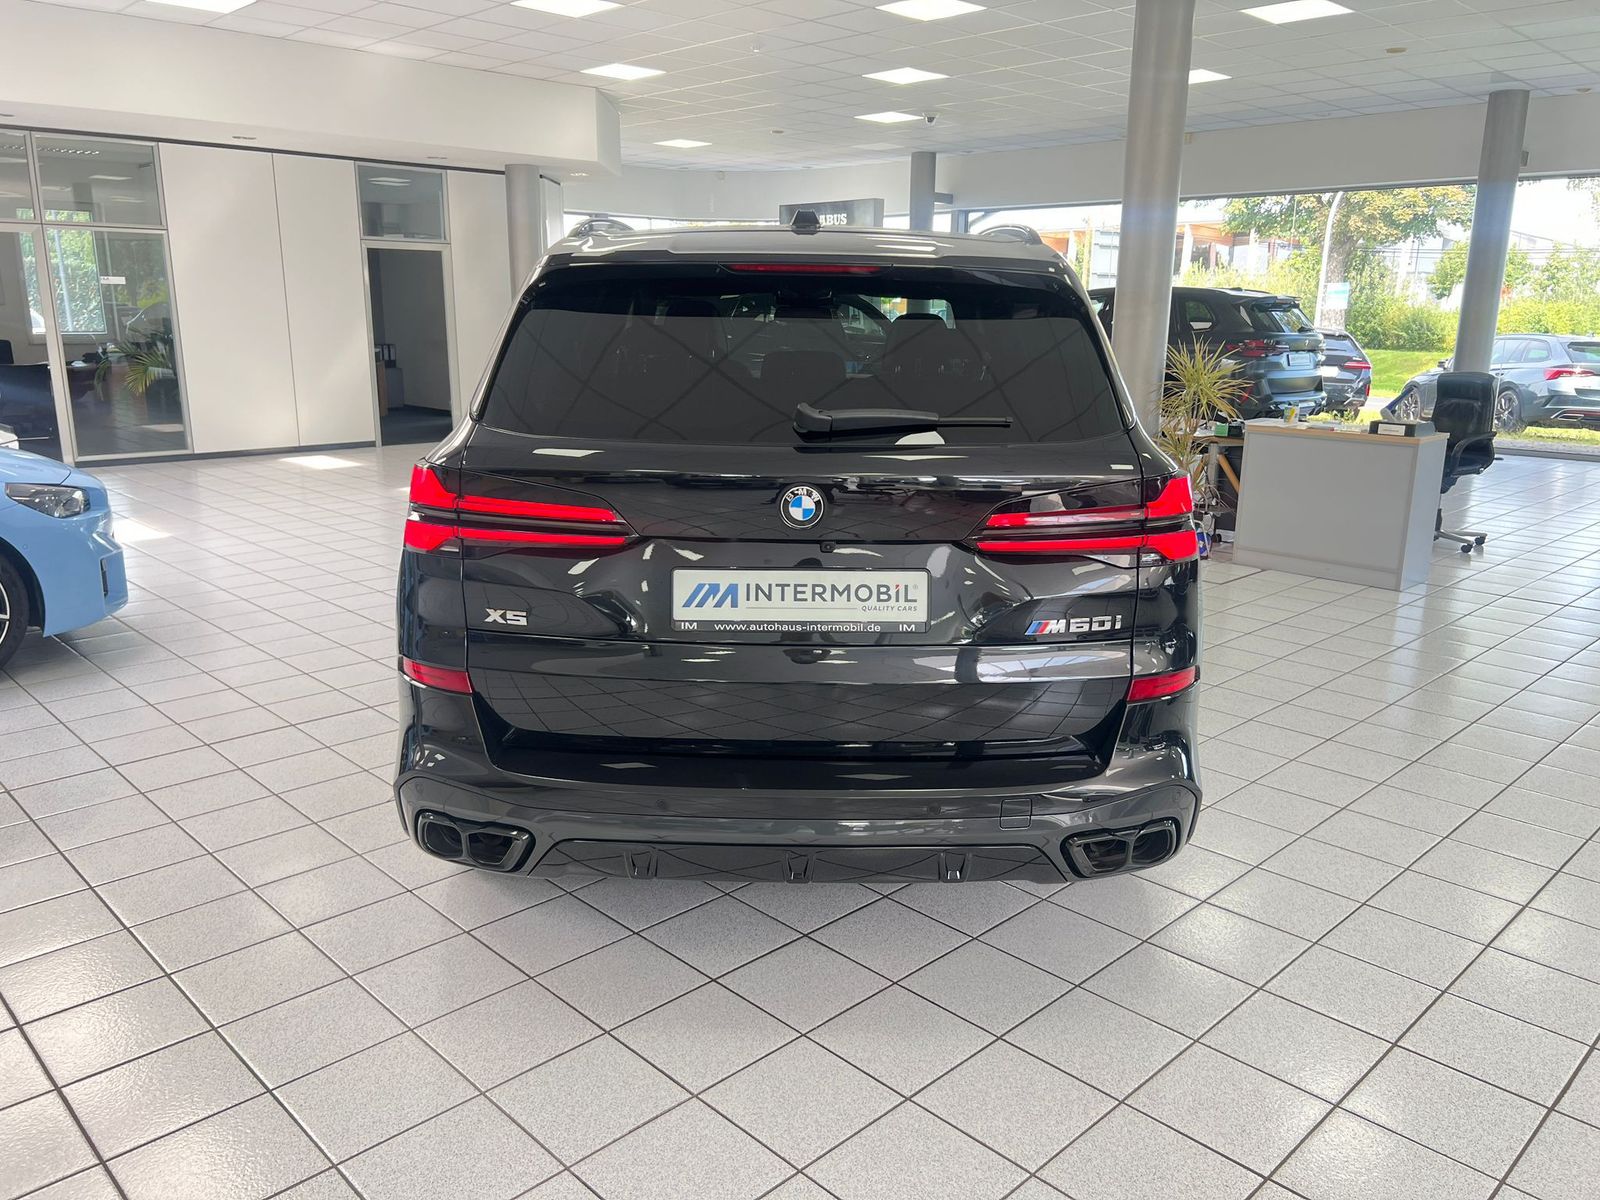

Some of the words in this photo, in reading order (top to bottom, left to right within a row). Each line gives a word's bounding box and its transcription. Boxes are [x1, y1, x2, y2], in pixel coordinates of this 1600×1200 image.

[819, 213, 848, 226] ABUS
[785, 487, 820, 502] BMW
[484, 608, 528, 626] X5
[1042, 615, 1122, 634] M60i
[681, 622, 698, 630] IM
[714, 622, 881, 632] www.autohaus-intermobil.de
[899, 624, 916, 632] IM
